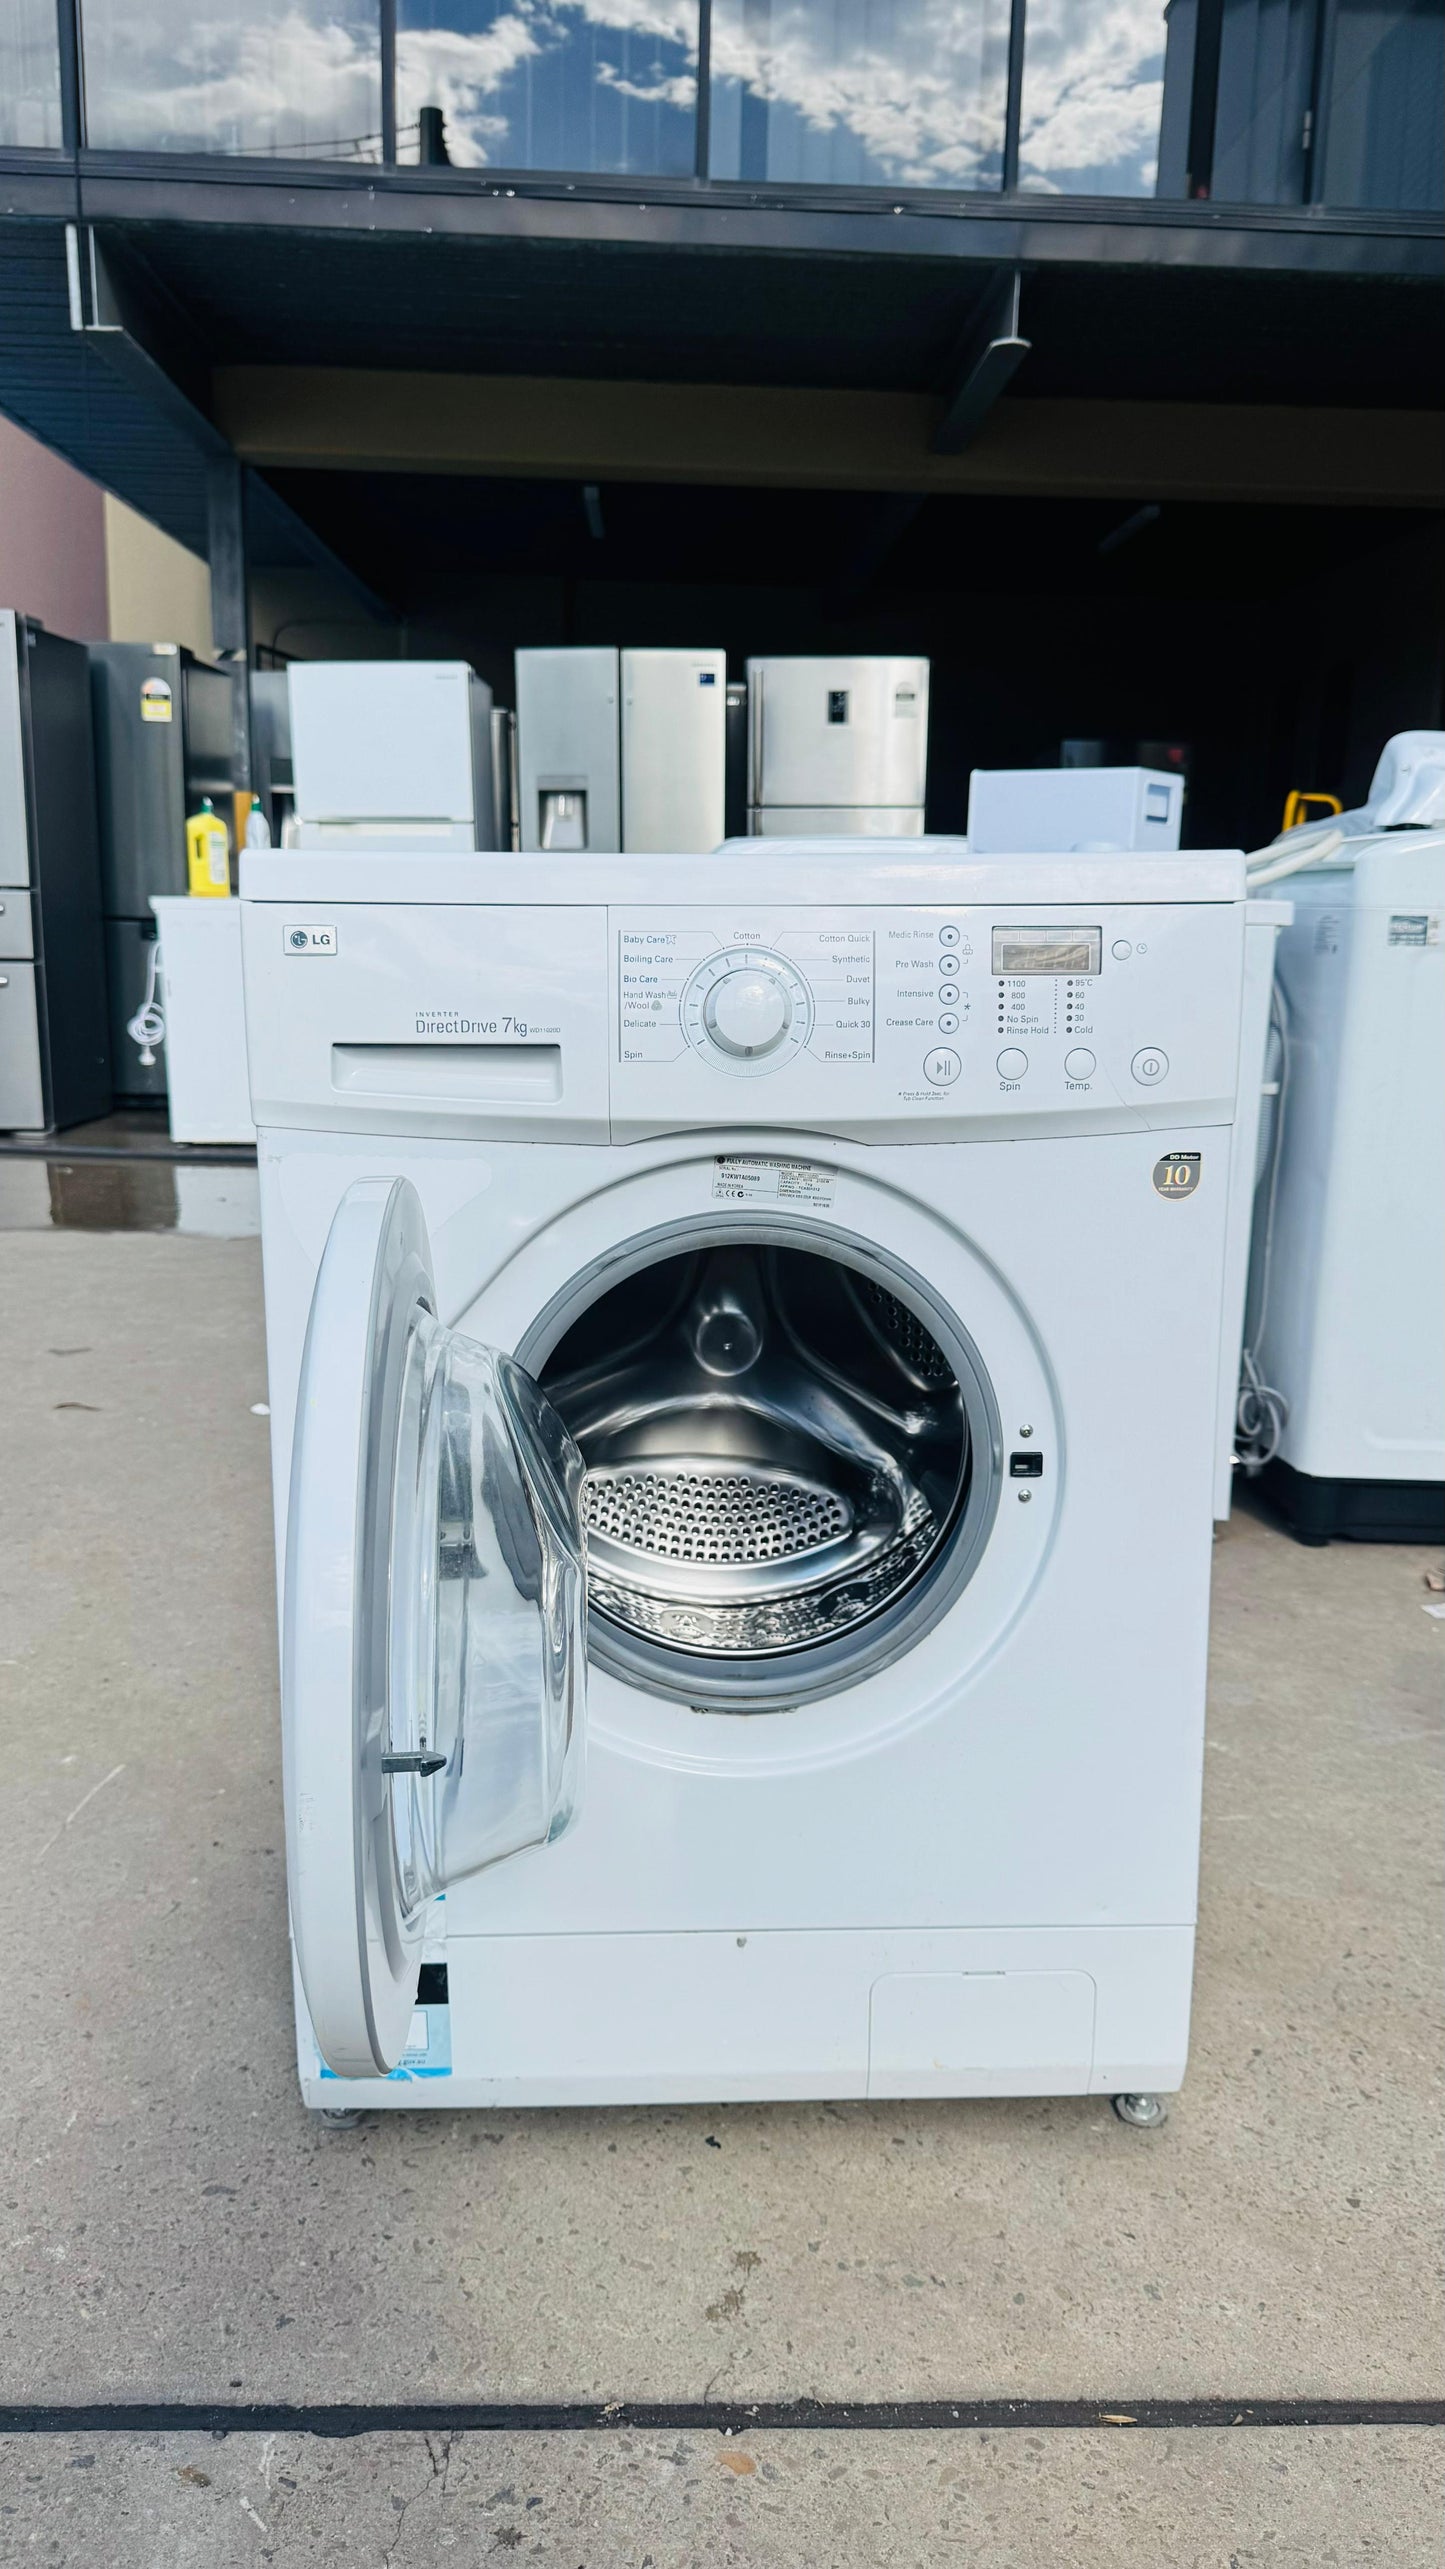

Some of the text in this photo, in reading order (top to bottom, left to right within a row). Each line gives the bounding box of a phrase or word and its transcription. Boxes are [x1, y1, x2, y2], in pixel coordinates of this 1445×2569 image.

[733, 931, 761, 940] Cotton
[819, 934, 871, 943] Cotton Quick
[888, 930, 934, 939] Medic Rinse
[312, 934, 331, 945] LG
[623, 935, 666, 945] Baby Care
[623, 955, 674, 964] Boiling Care
[832, 955, 871, 964] Synthetic
[895, 960, 934, 968] Pre Wash
[623, 975, 658, 983] Bio Care
[846, 975, 870, 983] Duvet
[623, 991, 666, 999] Hand Wash
[896, 989, 934, 998] Intensive
[624, 1001, 650, 1010] /Wool
[847, 997, 870, 1006] Bulky
[623, 1020, 657, 1028] Delicate
[886, 1018, 934, 1026] Crease Care
[1007, 1015, 1039, 1024] No Spin
[501, 1017, 528, 1037] 7kg
[835, 1020, 871, 1029] Quick 30
[1006, 1026, 1049, 1034] Rinse Hold
[1074, 1026, 1093, 1034] Cold
[624, 1051, 643, 1060] Spin
[825, 1051, 871, 1060] Rinse+Spin
[999, 1082, 1021, 1092] Spin
[1064, 1081, 1093, 1091] Temp.
[741, 1159, 769, 1167] AUTOMATIC
[769, 1161, 790, 1169] WASHING
[791, 1163, 811, 1171] MACHINE
[1163, 1164, 1191, 1186] 10
